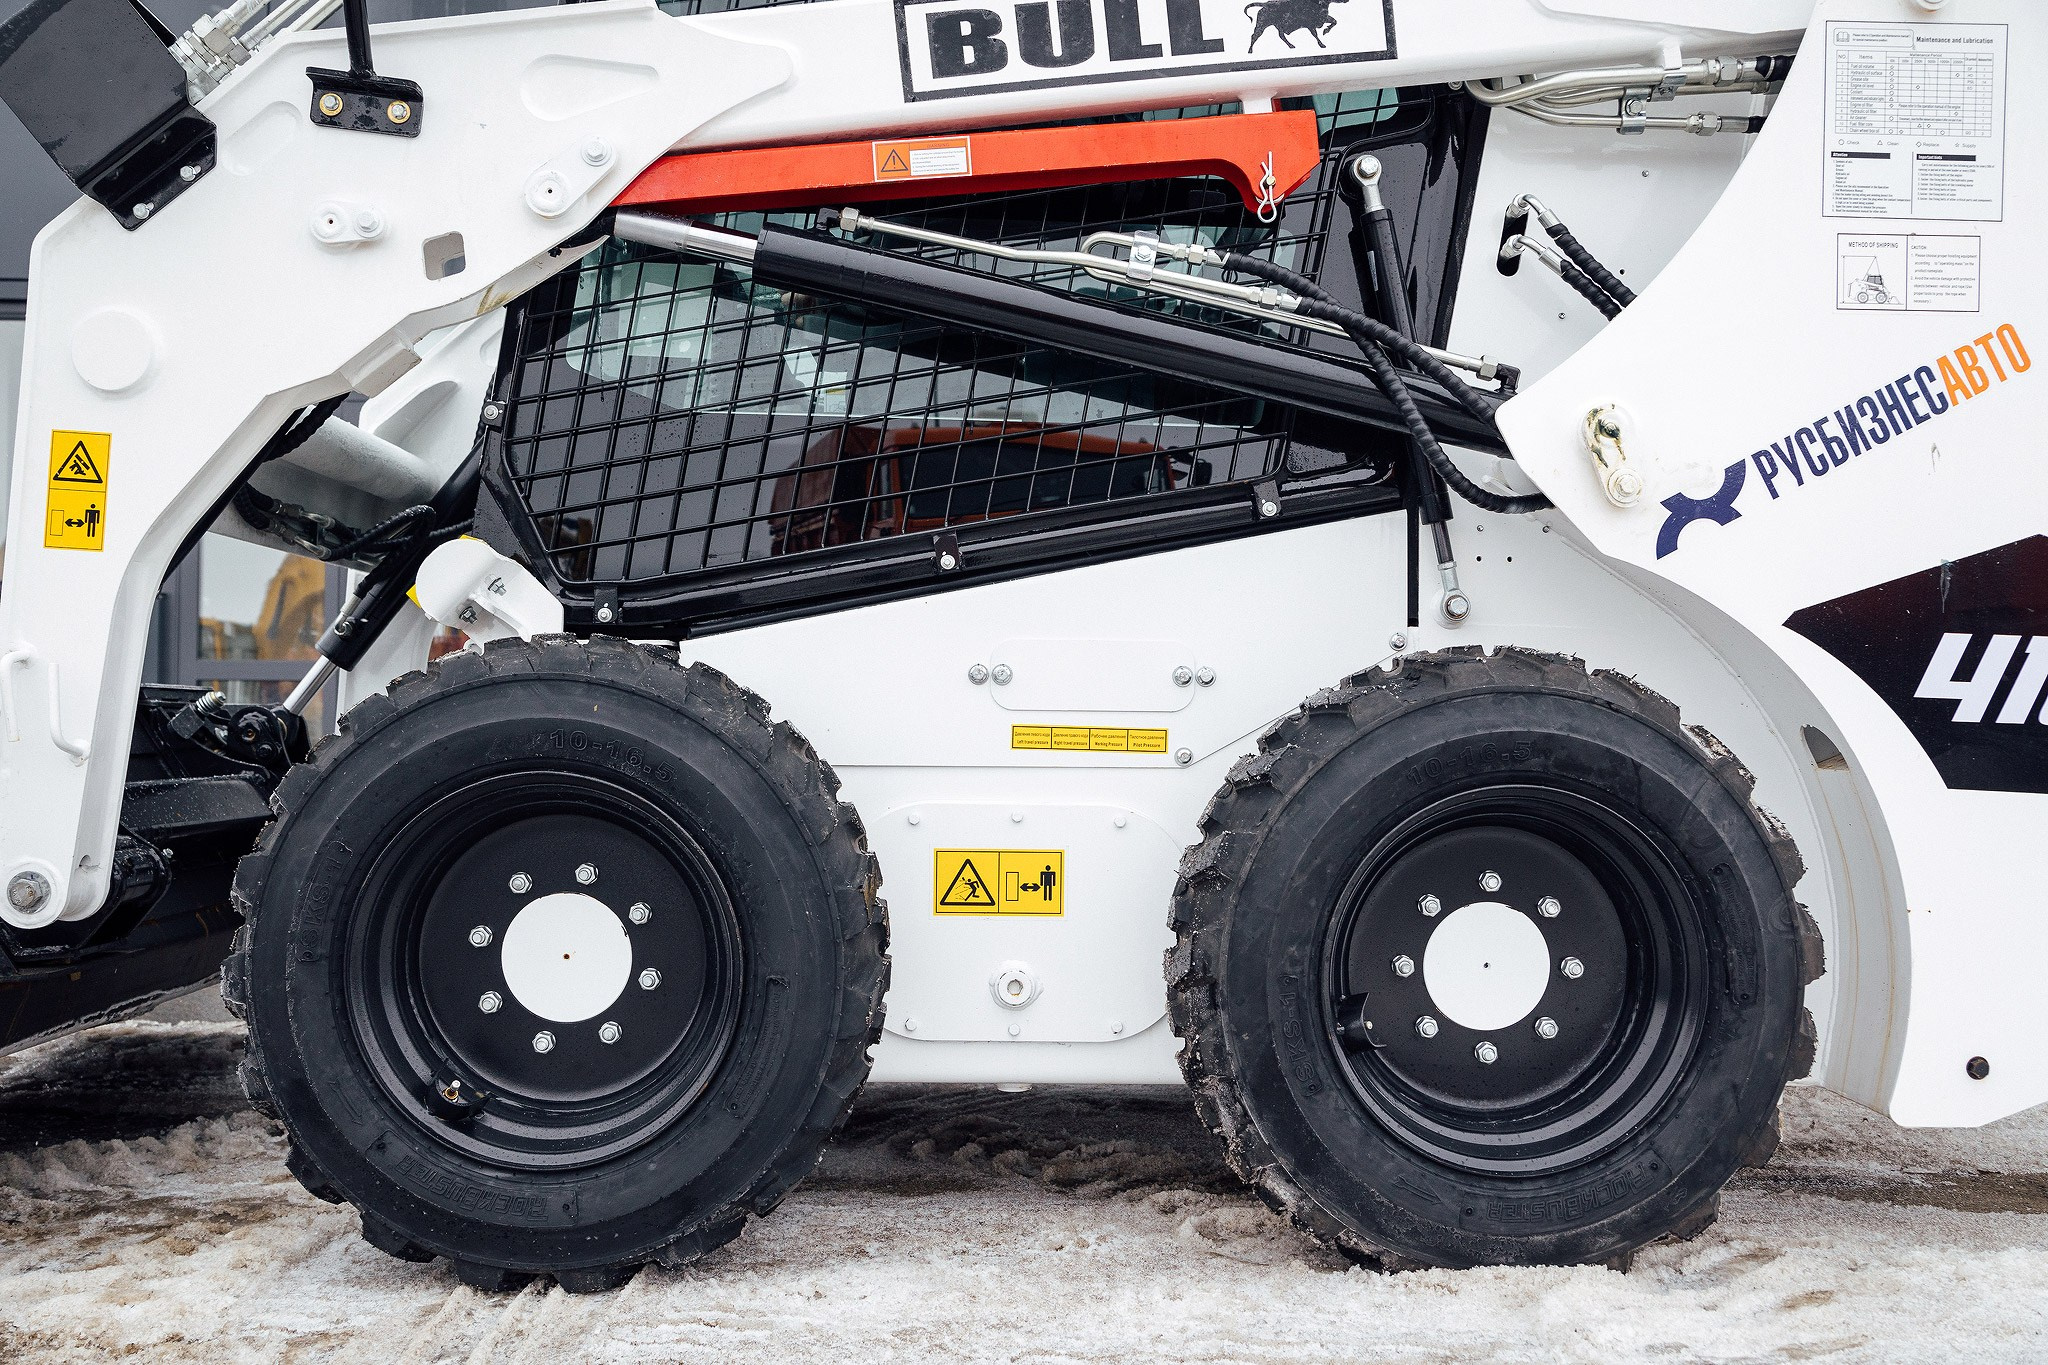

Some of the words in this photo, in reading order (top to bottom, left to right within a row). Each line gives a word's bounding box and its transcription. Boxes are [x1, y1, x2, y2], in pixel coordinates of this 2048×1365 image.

[925, 0, 1224, 79] BULL
[1751, 323, 2031, 500] РУСБИЗНЕСАВТО
[1912, 632, 2048, 725] 41
[550, 728, 676, 783] 10-16.5
[1407, 740, 1531, 785] 10-16.5
[1279, 992, 1315, 1082] SKS-1
[1487, 1162, 1655, 1223] ROCKBUSTER
